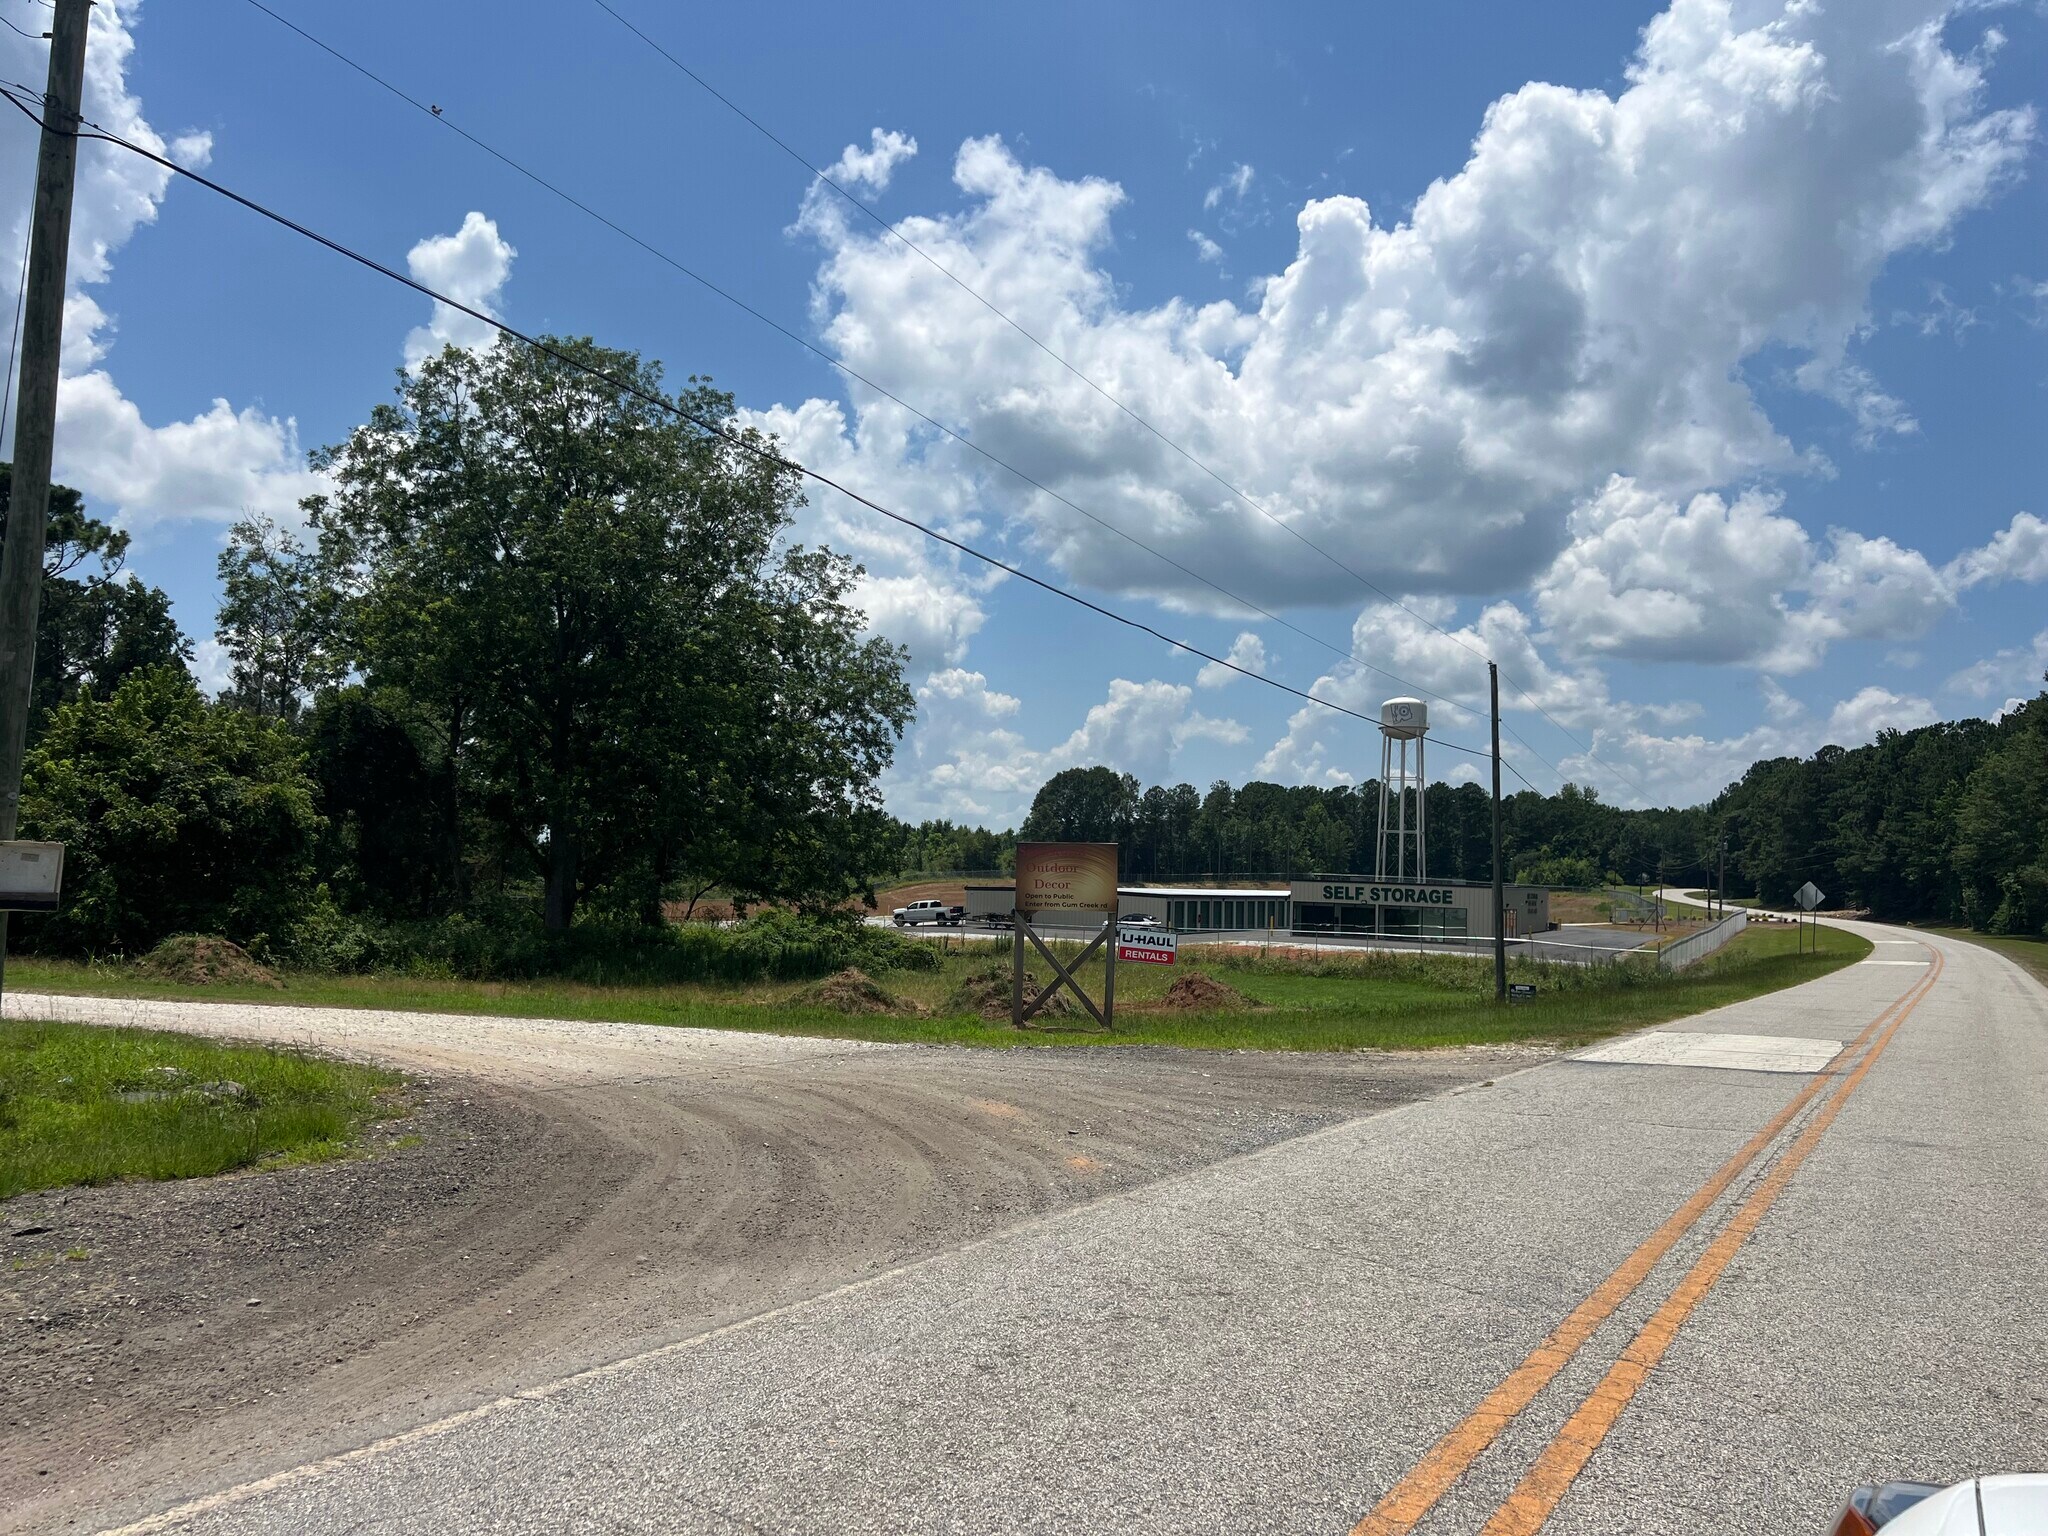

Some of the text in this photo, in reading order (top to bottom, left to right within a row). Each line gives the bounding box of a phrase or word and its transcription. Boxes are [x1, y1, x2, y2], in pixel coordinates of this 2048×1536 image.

[1026, 862, 1080, 873] Outdoor
[1034, 879, 1071, 889] Decor
[1322, 885, 1453, 905] SELF STORAGE
[1122, 933, 1174, 948] U-HAUL
[1125, 949, 1168, 962] RENTALS
